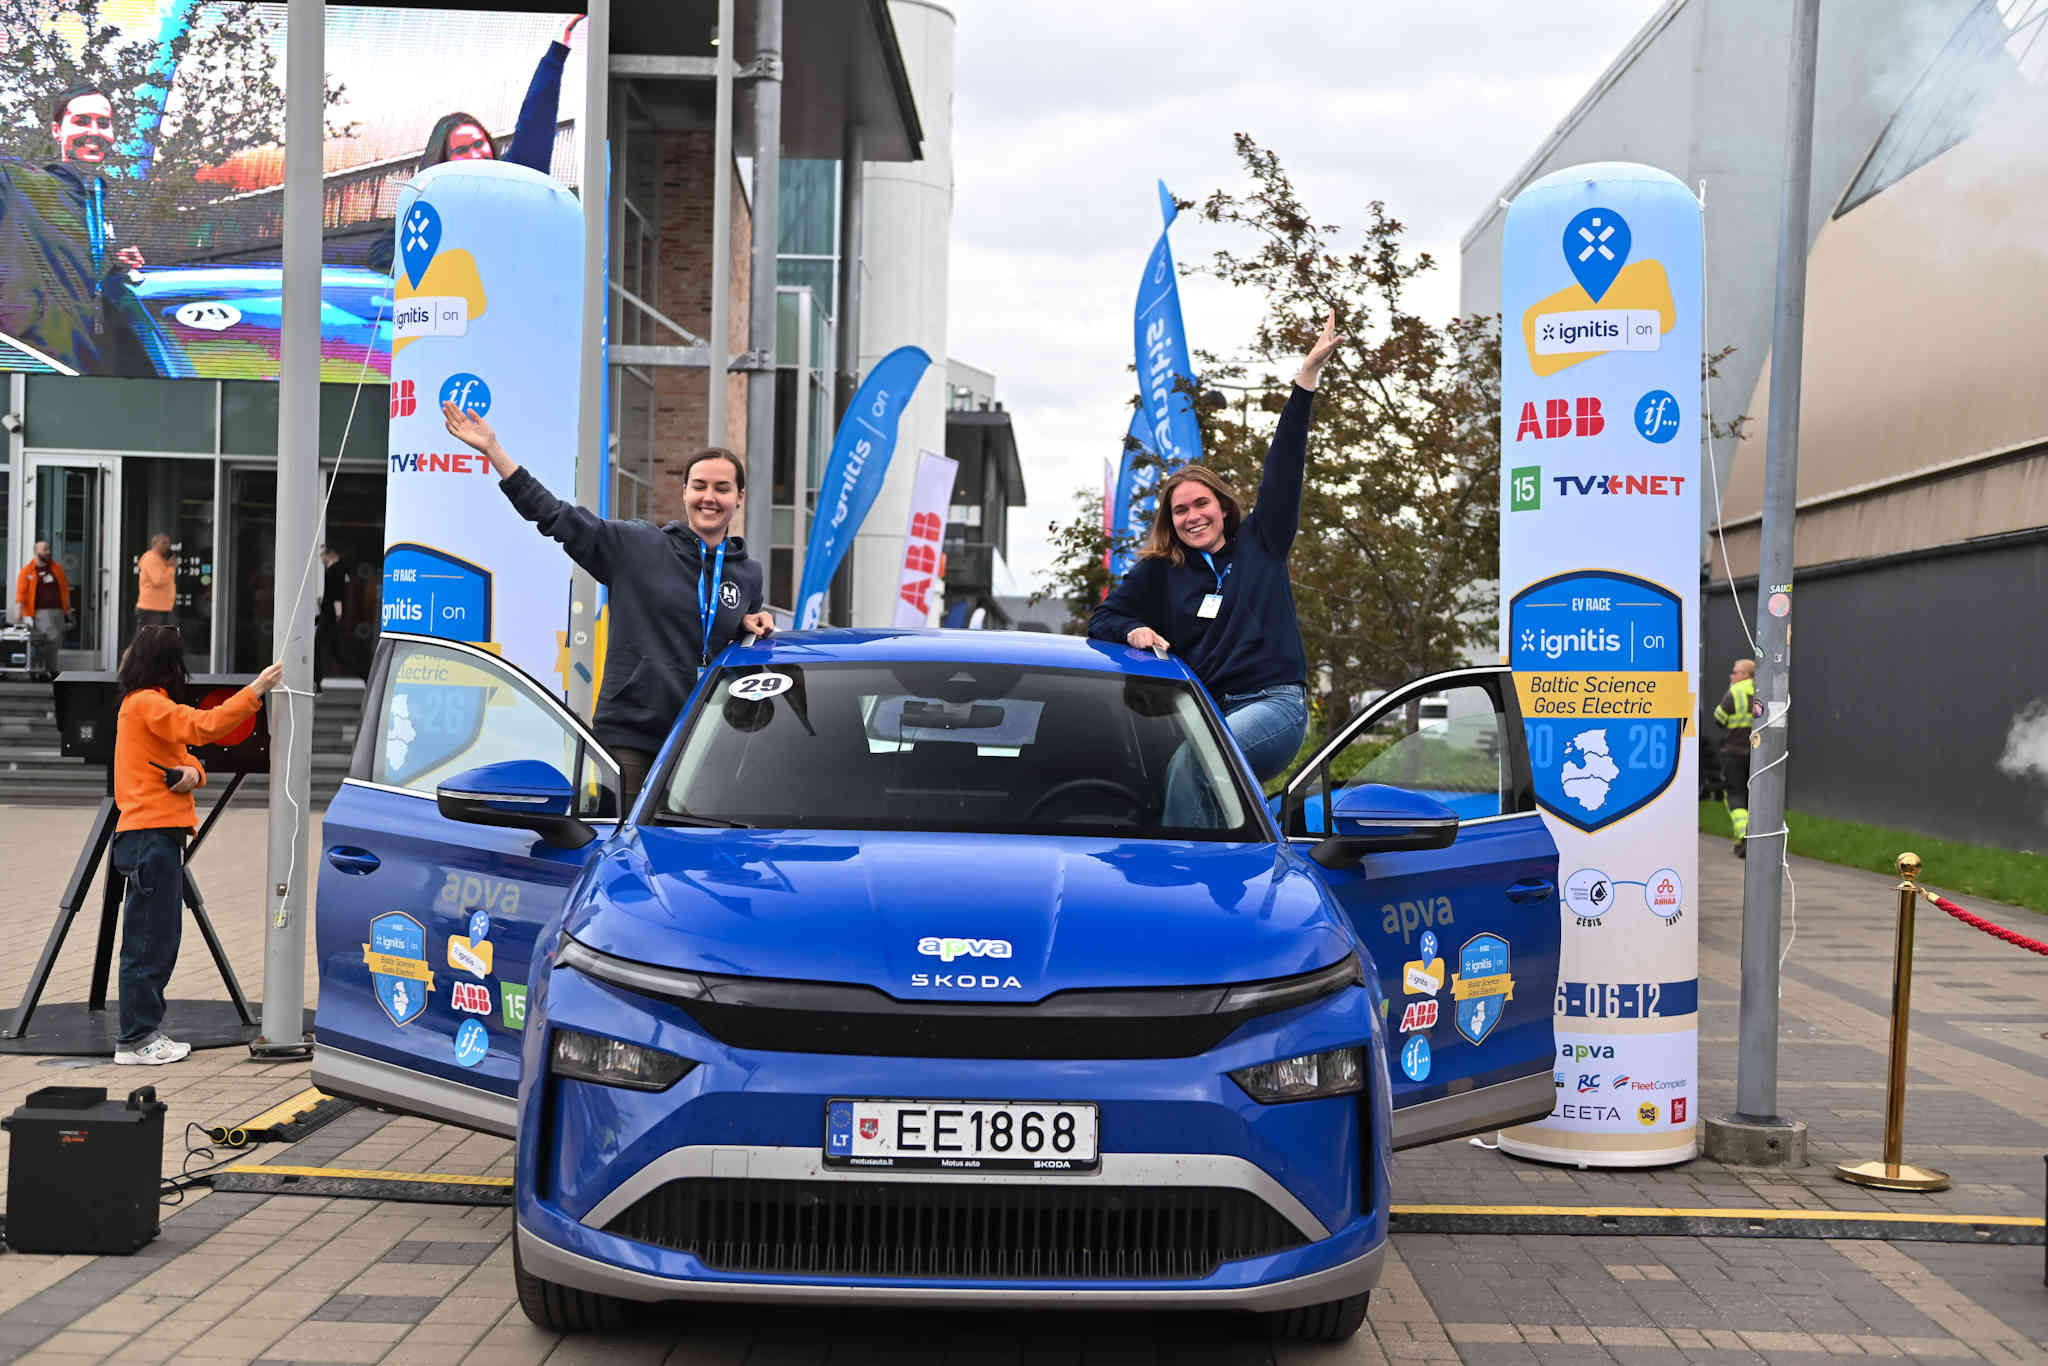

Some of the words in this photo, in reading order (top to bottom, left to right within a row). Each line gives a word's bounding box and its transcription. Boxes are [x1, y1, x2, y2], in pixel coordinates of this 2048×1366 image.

[397, 307, 429, 329] ignitis
[443, 310, 459, 321] on
[1559, 320, 1619, 344] ignitis
[1635, 324, 1653, 336] on
[872, 389, 889, 418] on
[1516, 397, 1605, 442] ABB
[1513, 476, 1535, 502] 15
[900, 511, 942, 616] ABB
[442, 605, 466, 620] on
[1571, 597, 1584, 611] EV
[1586, 597, 1611, 611] RACE
[1540, 627, 1621, 659] ignitis
[1643, 635, 1665, 649] on
[400, 661, 449, 681] lectric
[739, 677, 782, 693] 29
[1531, 676, 1579, 693] Baltic
[1584, 675, 1656, 693] Science
[1534, 697, 1577, 714] Goes
[1582, 697, 1653, 714] Electric
[1628, 724, 1667, 769] 26
[441, 872, 521, 918] apva
[1381, 896, 1455, 945] apva
[920, 938, 1010, 960] apva
[453, 984, 490, 1012] ABB
[505, 992, 526, 1020] 15
[1403, 1003, 1437, 1030] ABB
[1561, 1043, 1615, 1063] apva
[1577, 1074, 1601, 1089] RC
[833, 1134, 849, 1147] LT
[896, 1109, 1076, 1153] EE1868
[965, 1160, 981, 1168] auto
